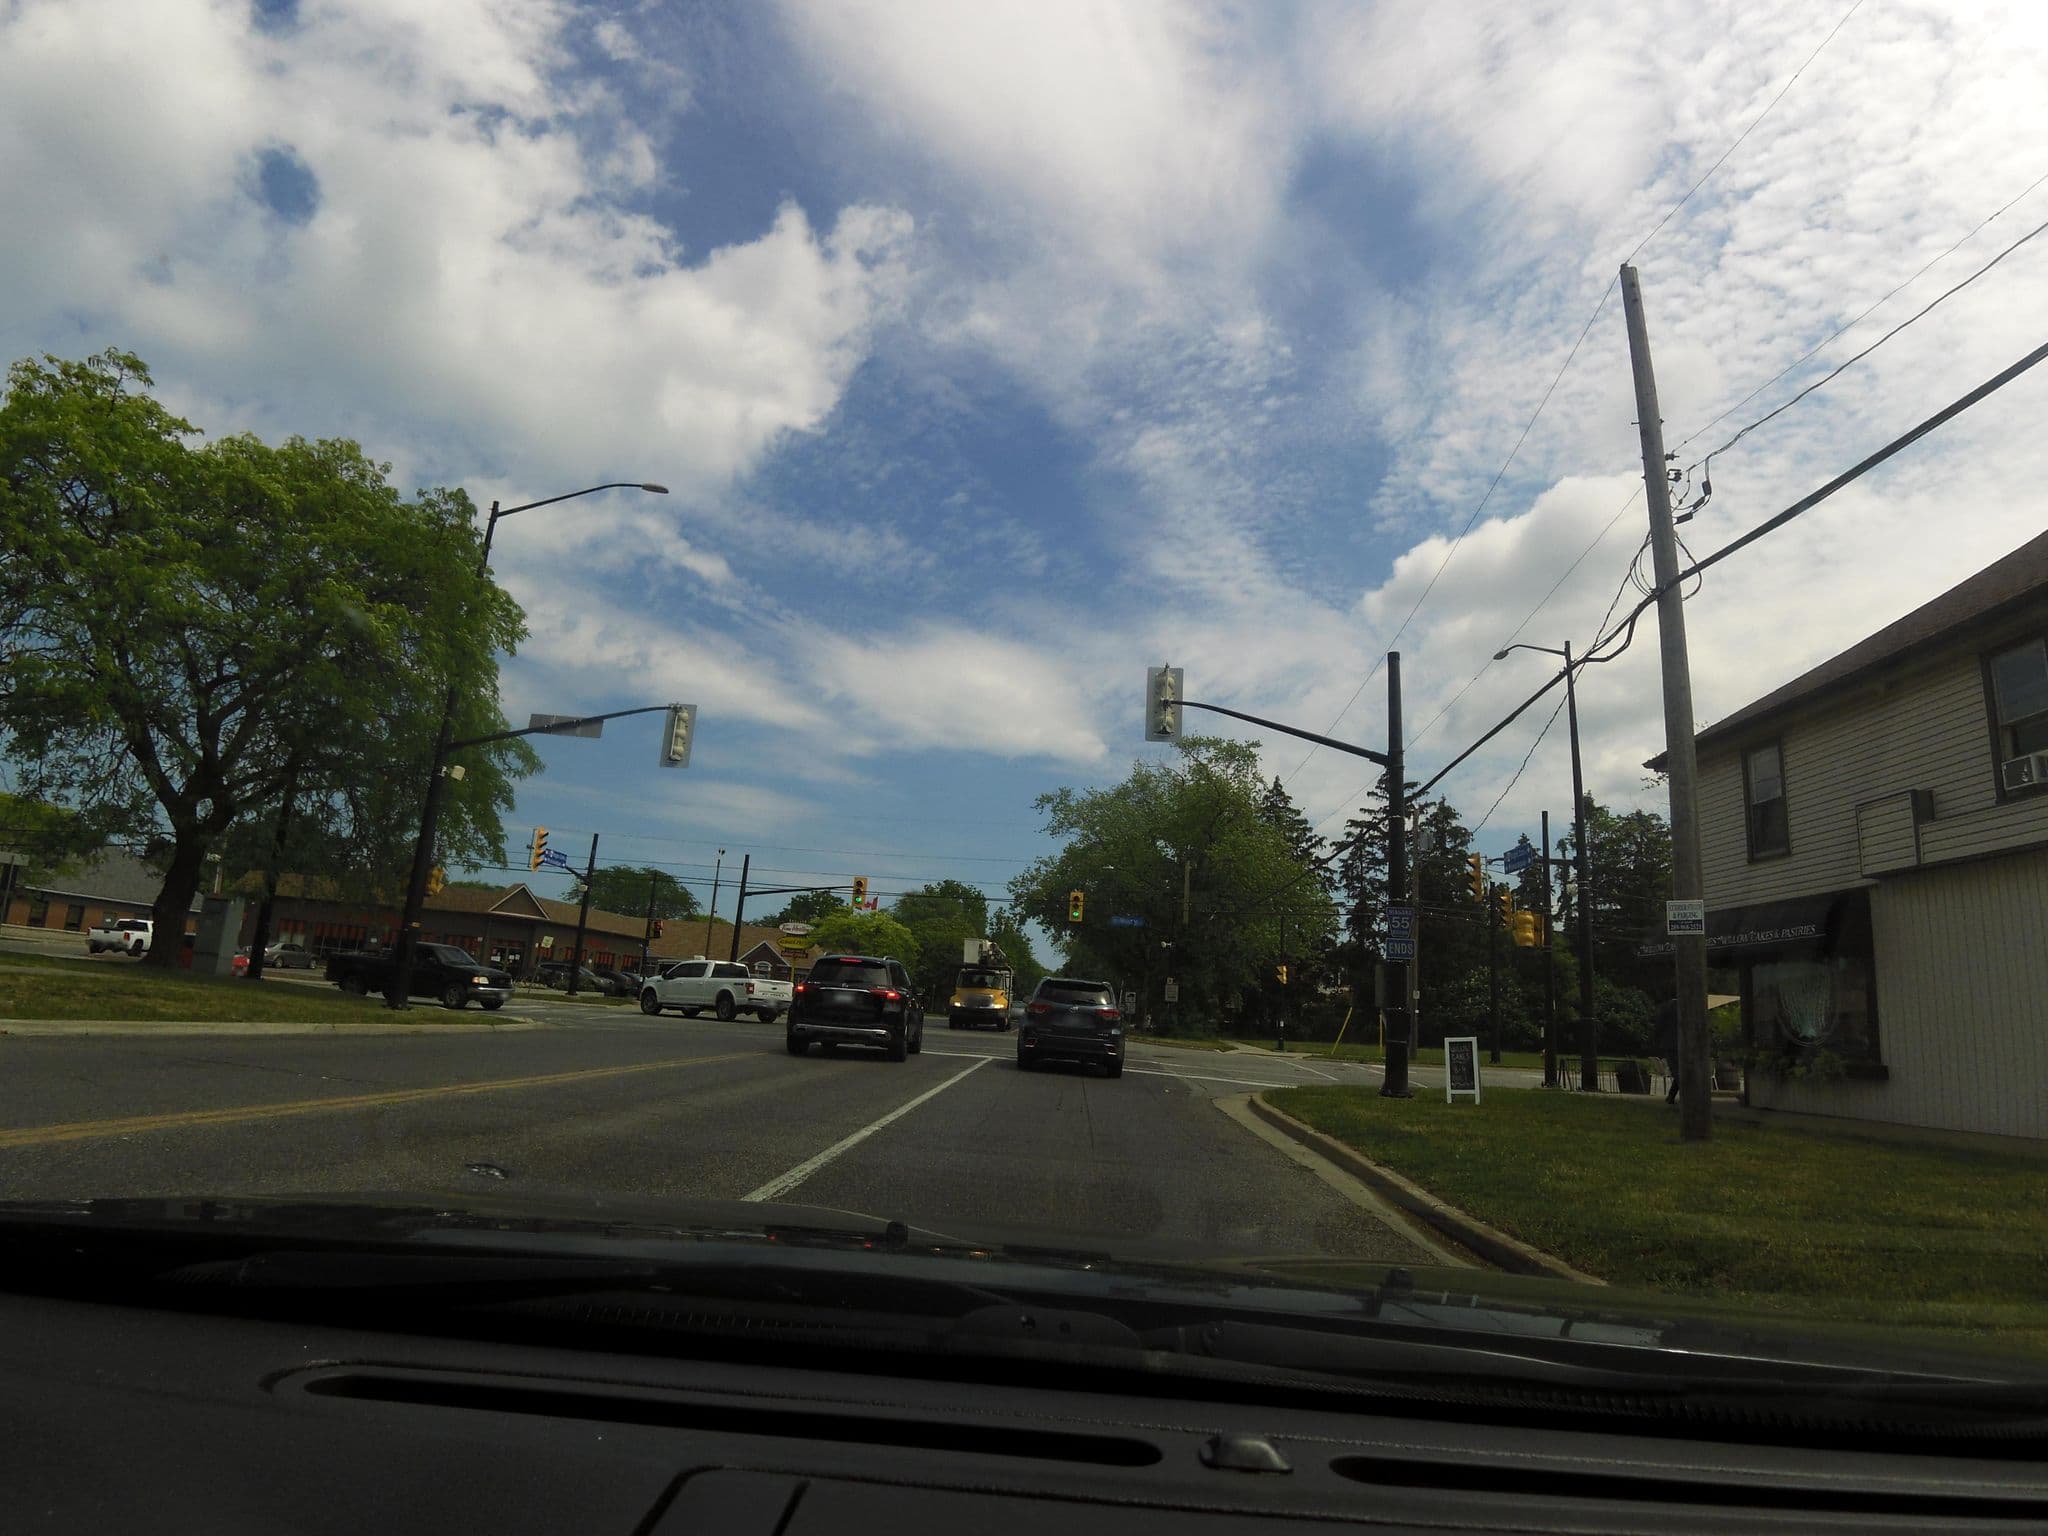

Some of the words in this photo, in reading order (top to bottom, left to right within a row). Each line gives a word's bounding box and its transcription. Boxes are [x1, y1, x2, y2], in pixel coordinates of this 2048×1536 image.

[1391, 916, 1410, 928] 55
[1781, 924, 1816, 937] PASTRIES
[1388, 942, 1414, 955] ENDS
